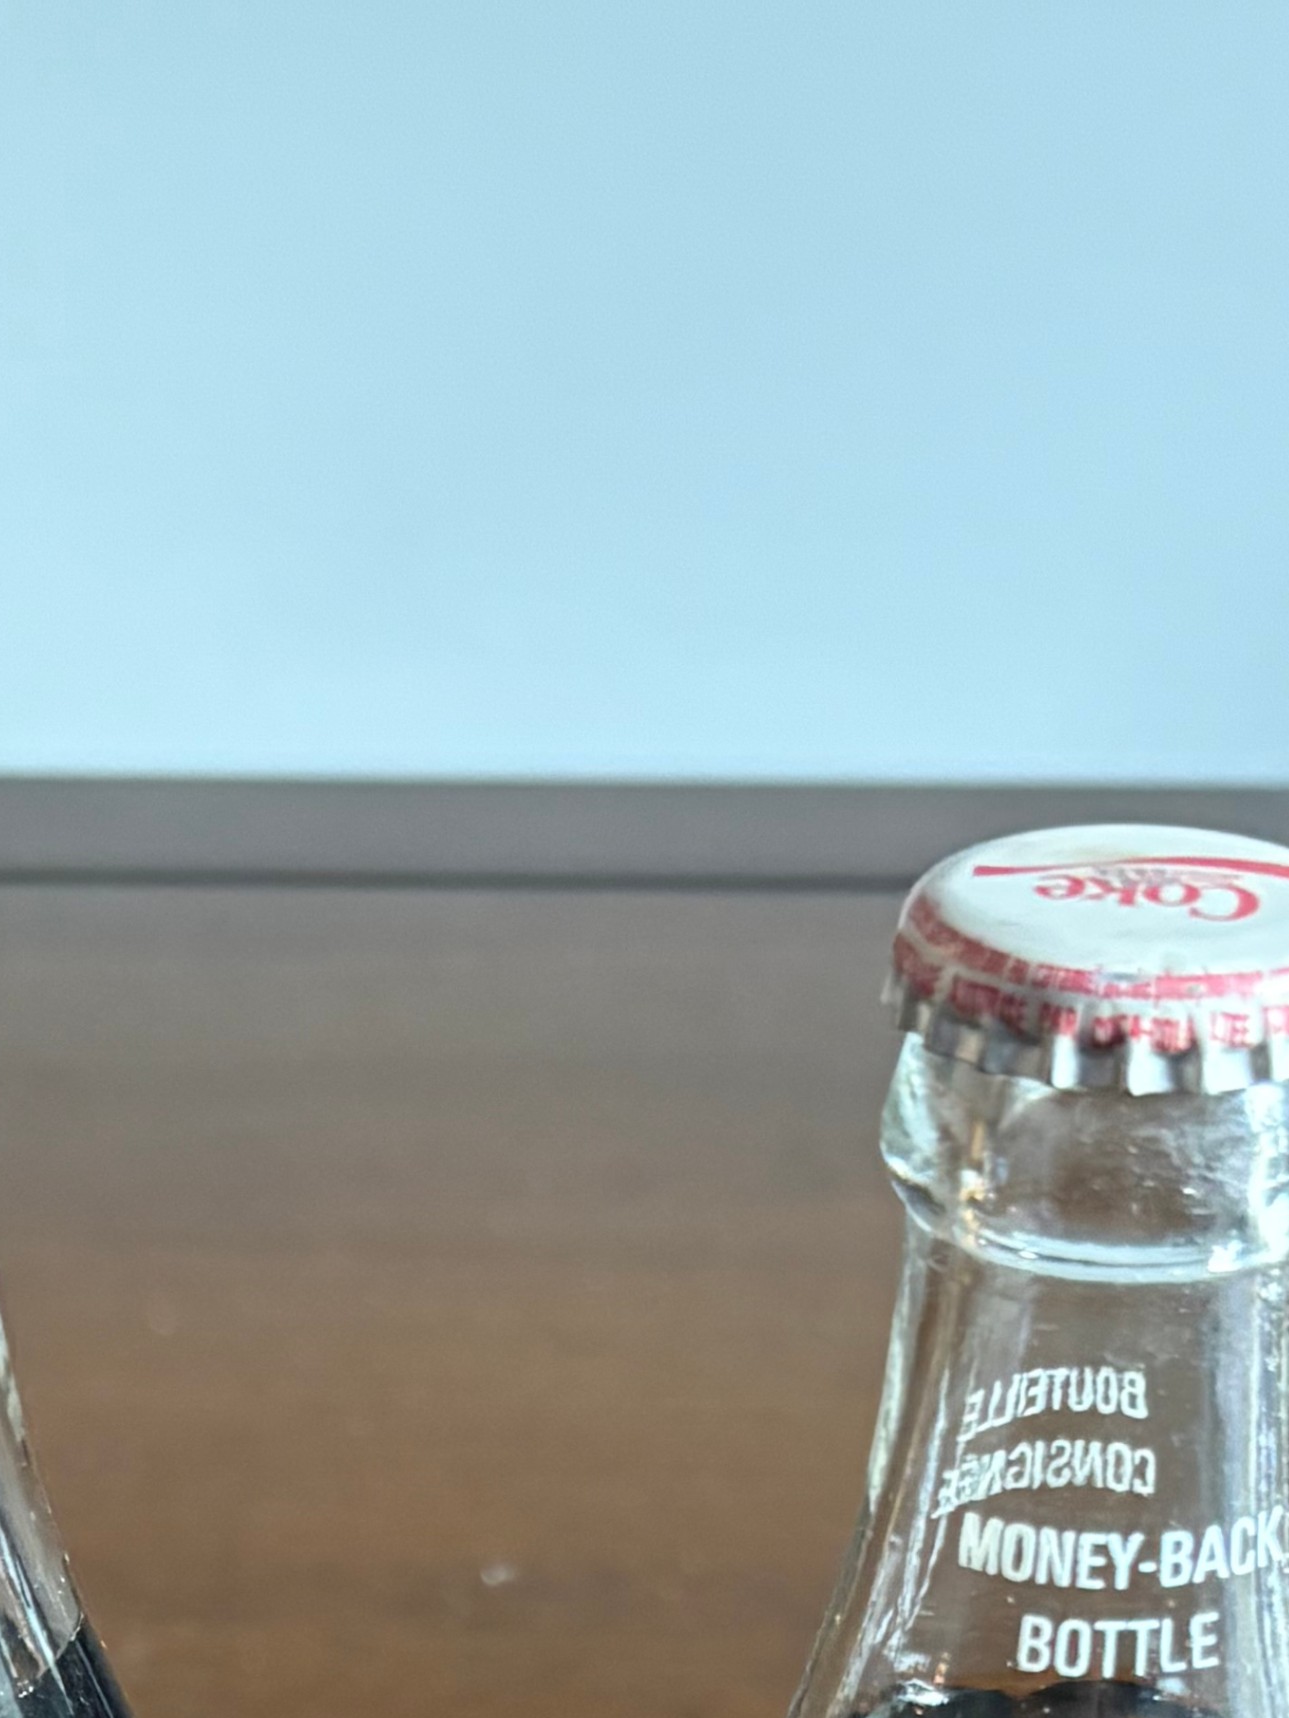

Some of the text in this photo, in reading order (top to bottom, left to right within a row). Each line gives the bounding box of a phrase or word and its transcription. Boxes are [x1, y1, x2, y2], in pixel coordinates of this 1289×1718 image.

[1033, 874, 1261, 923] Coke
[957, 1505, 1288, 1591] MONEY-BACK
[1016, 1611, 1222, 1679] BOTTLE
